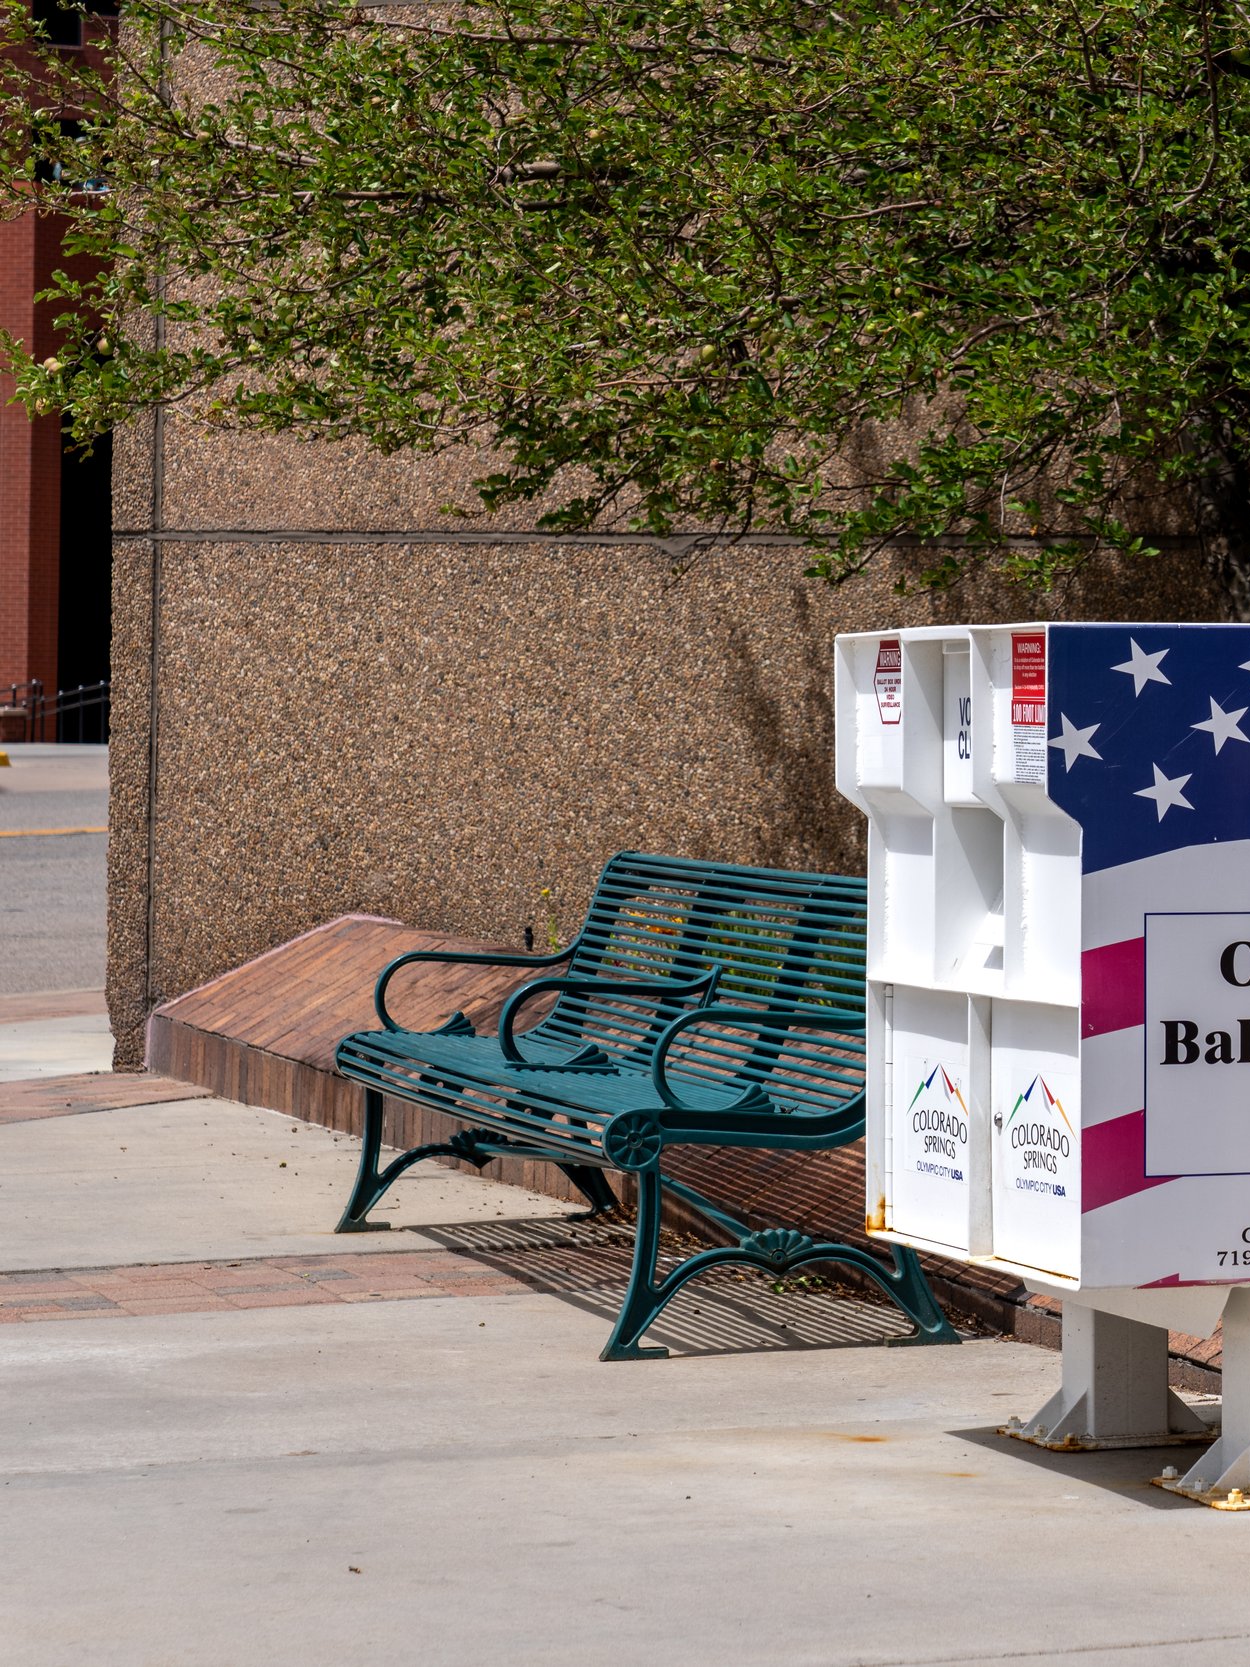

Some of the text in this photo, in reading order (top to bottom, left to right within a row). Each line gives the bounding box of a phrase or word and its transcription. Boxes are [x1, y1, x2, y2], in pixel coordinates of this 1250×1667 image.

[1013, 703, 1022, 722] 100
[1023, 703, 1034, 722] FOOT
[912, 1109, 968, 1144] COLORADO
[924, 1135, 956, 1159] SPRINGS
[1011, 1123, 1070, 1158] COLORADO
[1023, 1150, 1058, 1175] SPRINGS
[950, 1169, 964, 1182] USA
[1052, 1185, 1066, 1198] USA
